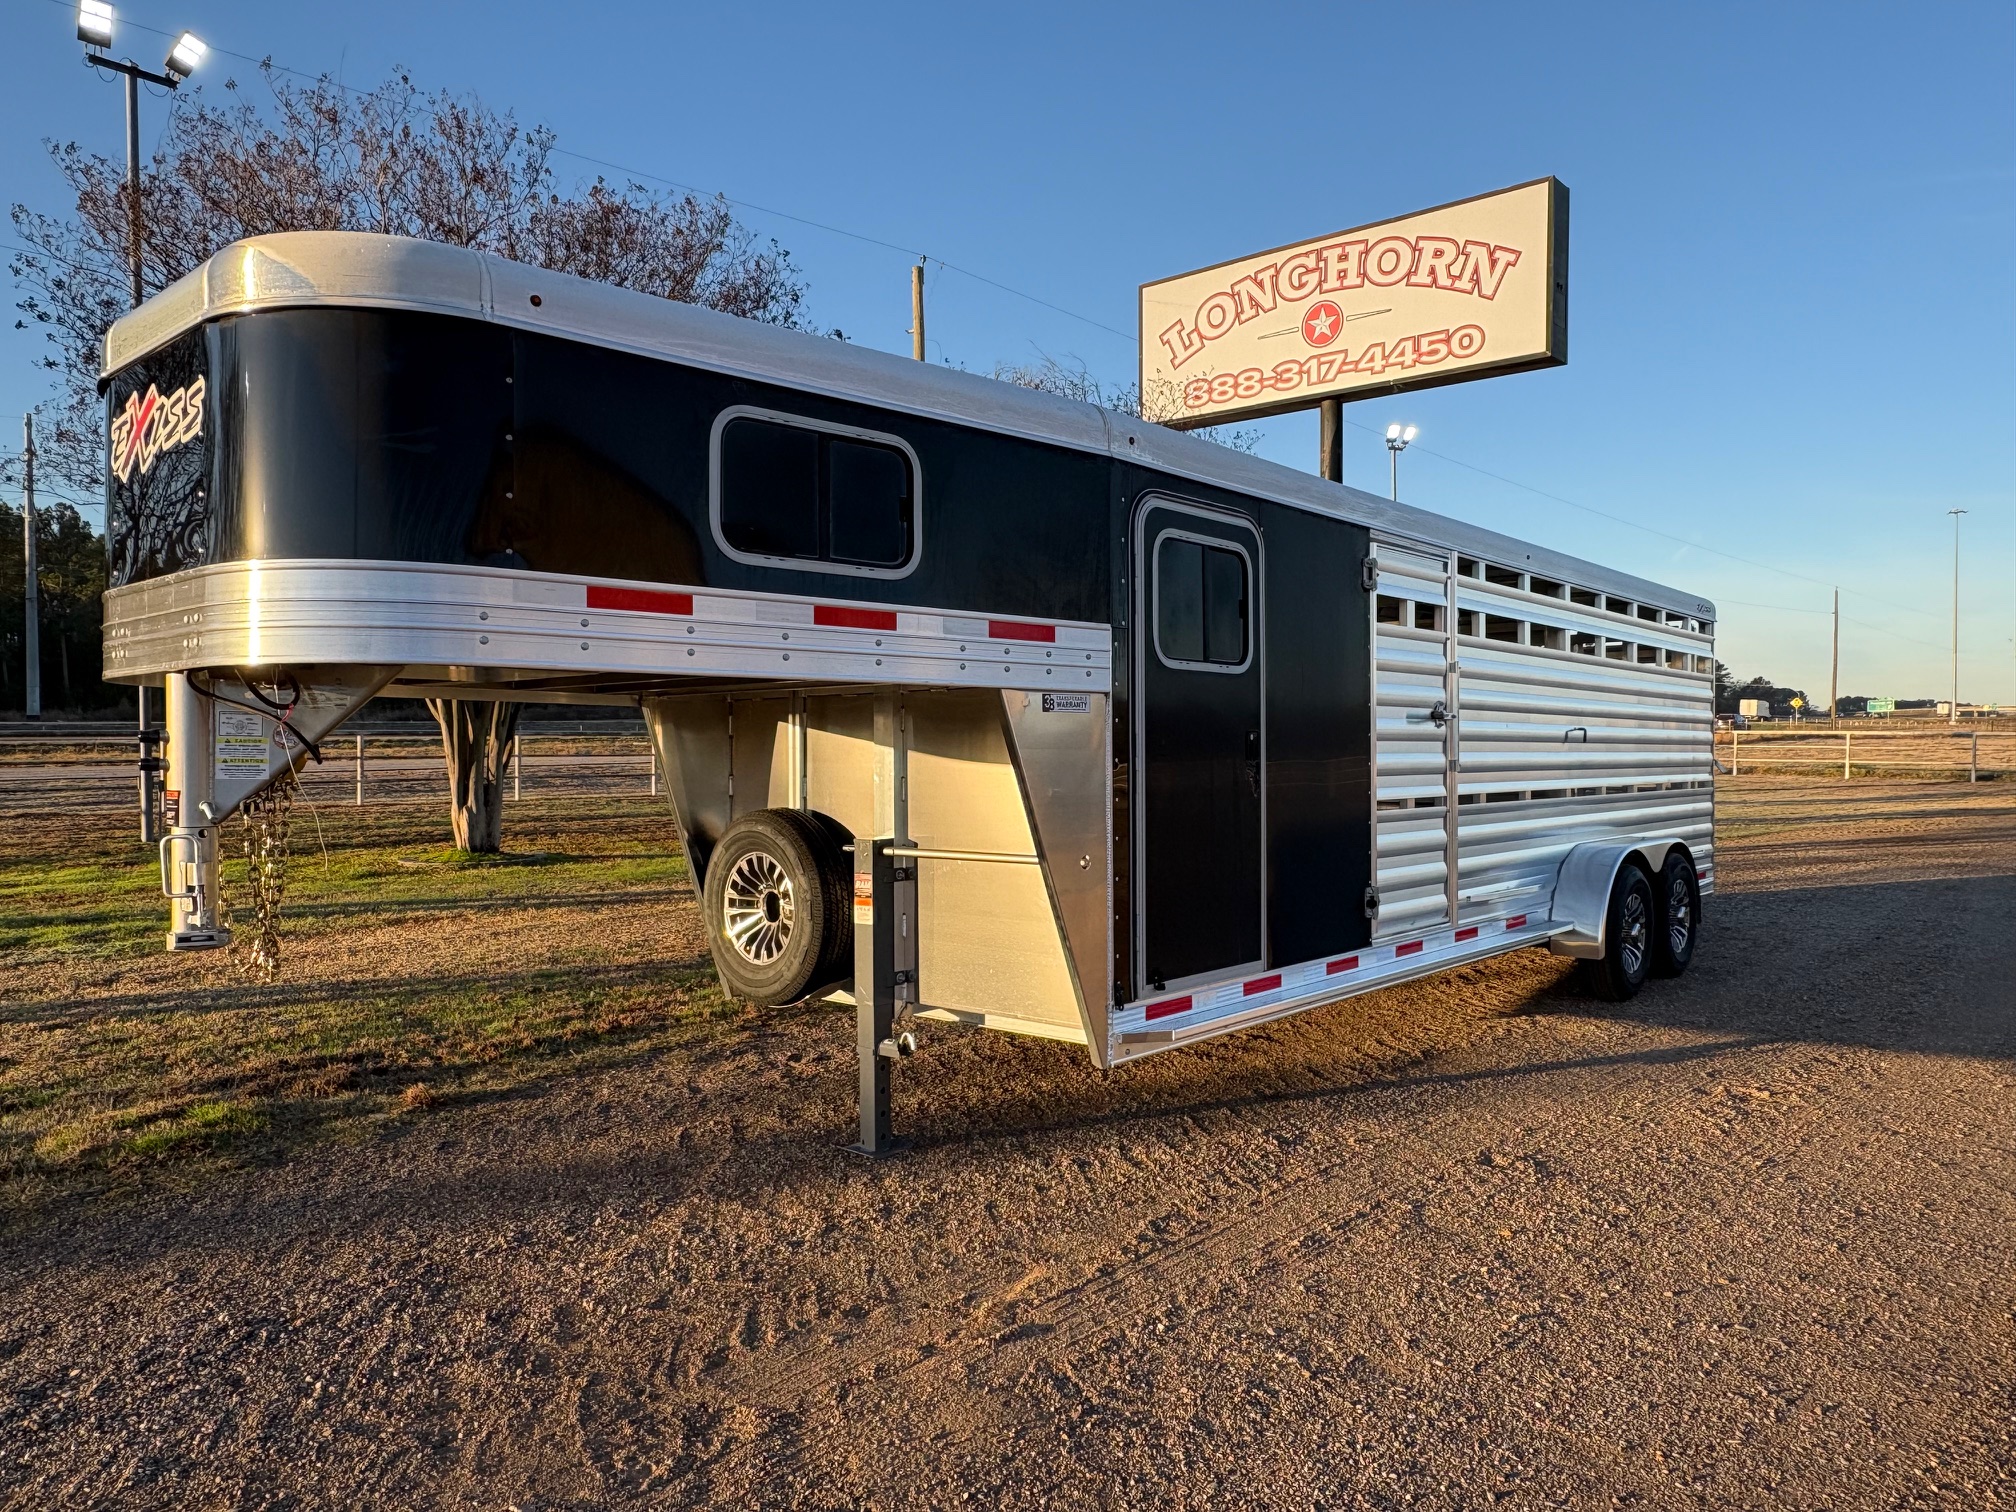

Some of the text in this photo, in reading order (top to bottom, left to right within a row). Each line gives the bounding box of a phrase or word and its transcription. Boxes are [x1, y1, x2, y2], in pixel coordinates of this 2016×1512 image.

[1159, 236, 1522, 370] LONGHORN
[1185, 324, 1486, 409] 888-317-4450
[1056, 701, 1088, 709] WARRANTY
